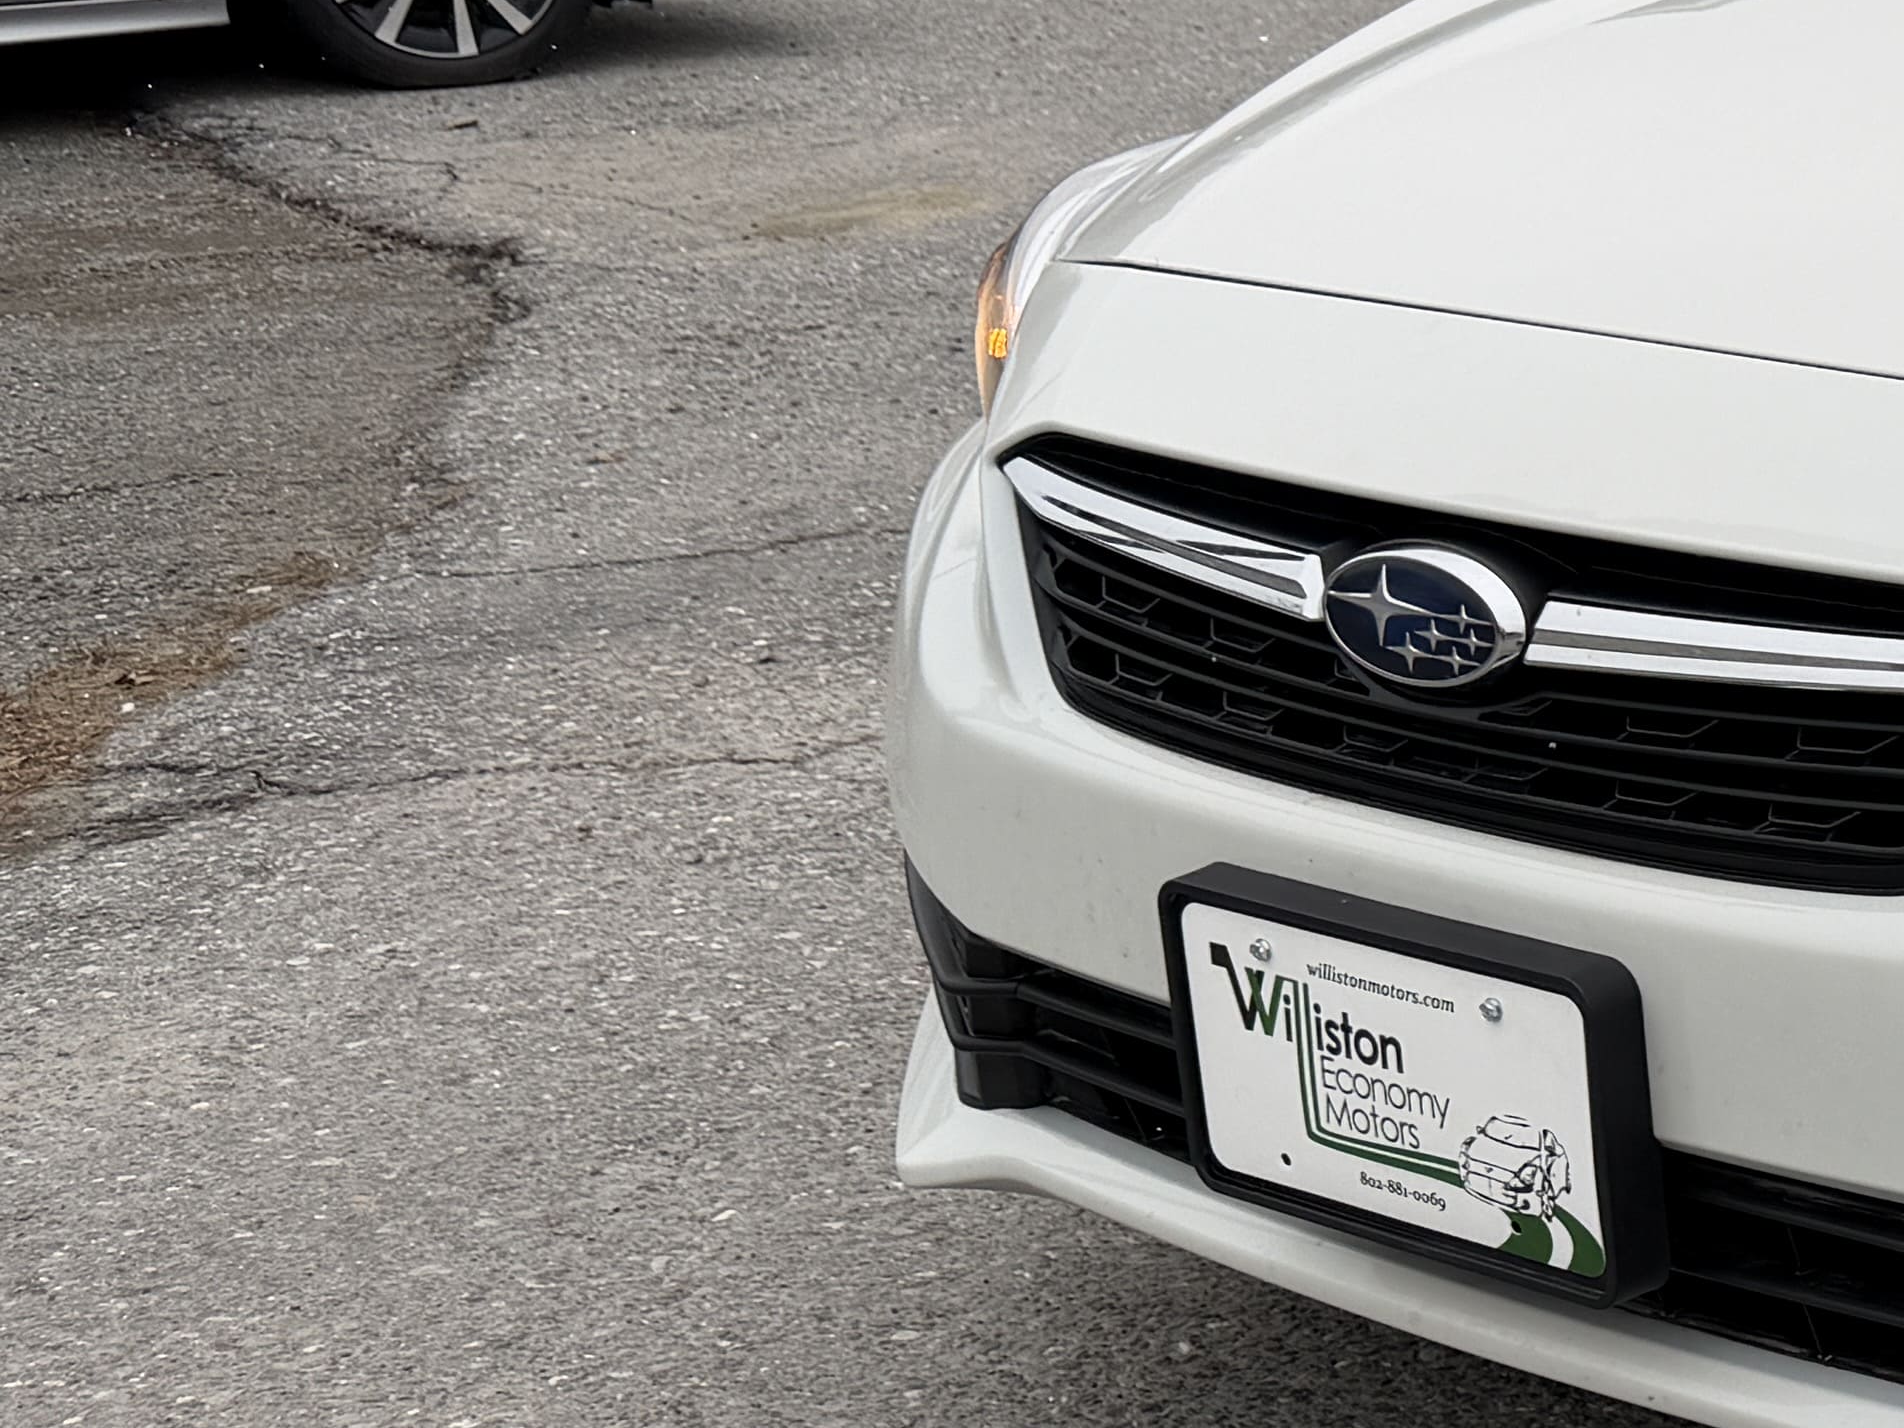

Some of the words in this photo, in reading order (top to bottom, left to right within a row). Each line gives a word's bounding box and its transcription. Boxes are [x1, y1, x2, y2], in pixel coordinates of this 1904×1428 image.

[1209, 941, 1404, 1074] Williston
[1306, 963, 1455, 1013] willistonmotors.com
[1320, 1055, 1450, 1129] Economy
[1326, 1093, 1421, 1150] Motors
[1360, 1171, 1446, 1211] 802-881-0069
